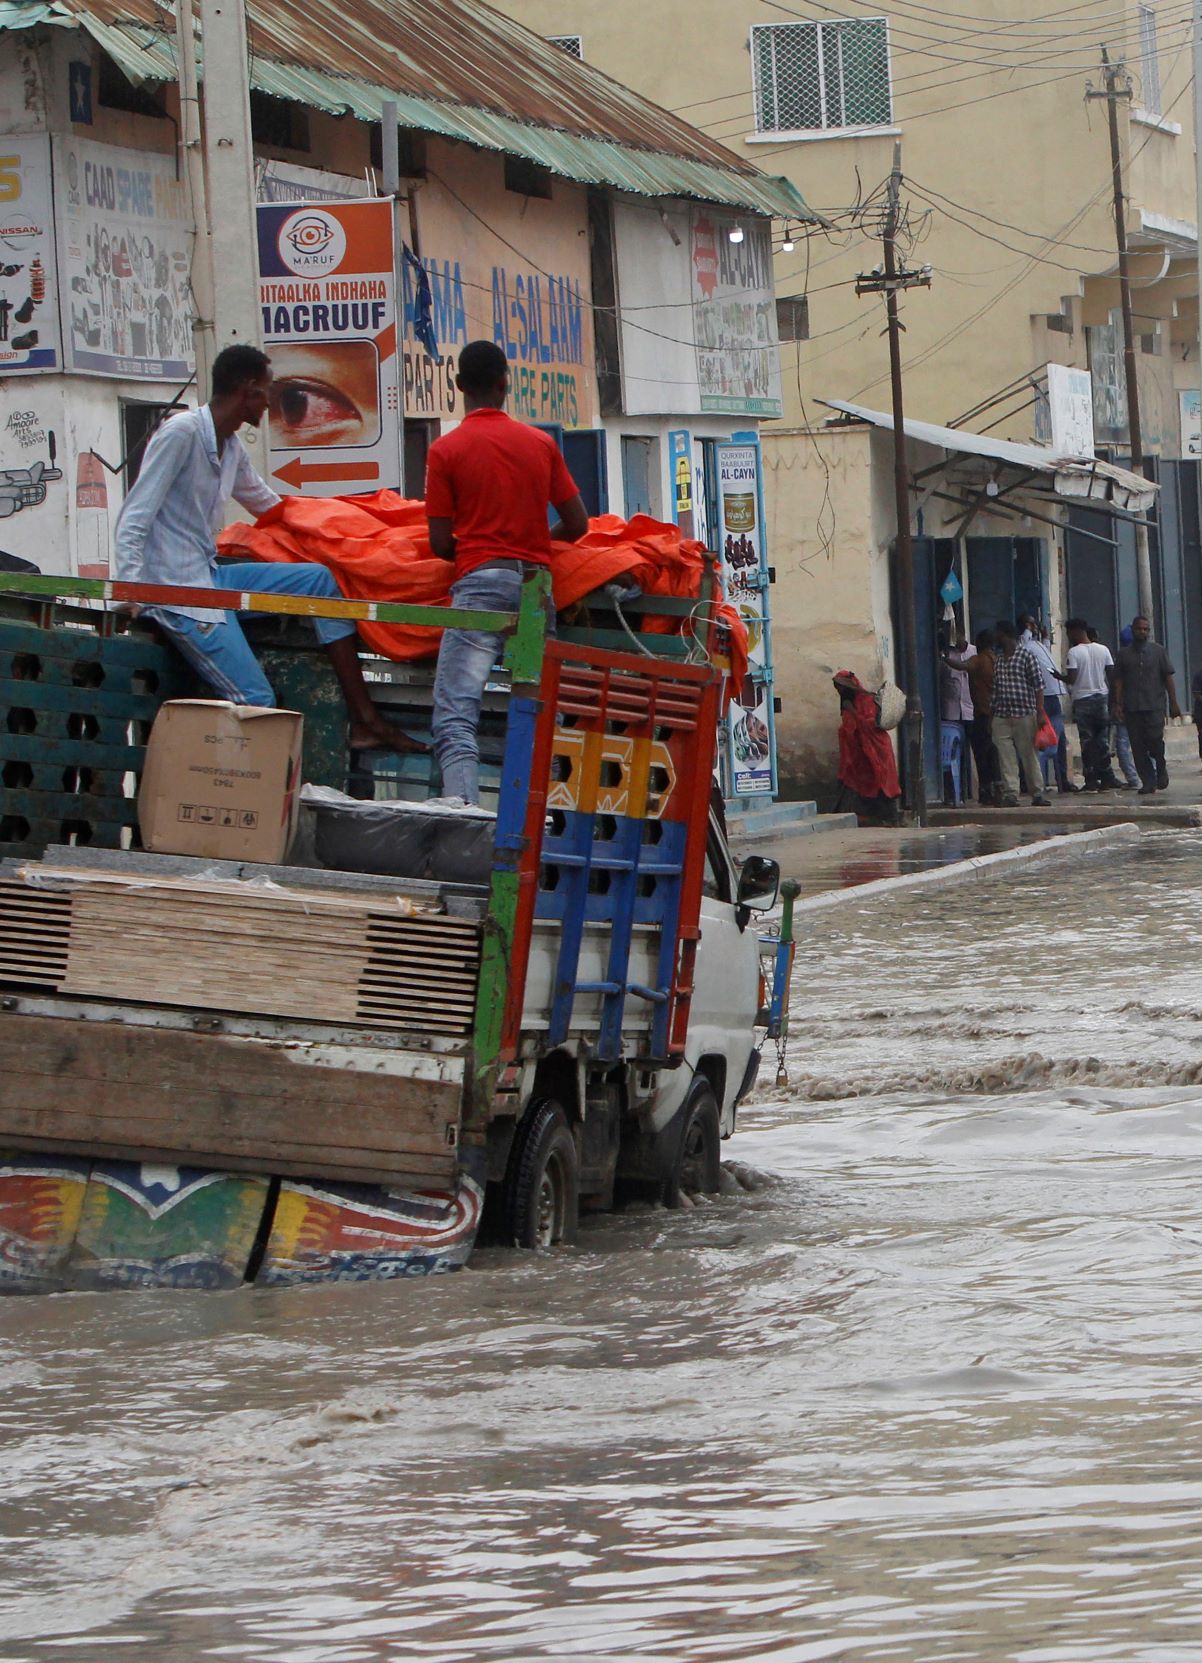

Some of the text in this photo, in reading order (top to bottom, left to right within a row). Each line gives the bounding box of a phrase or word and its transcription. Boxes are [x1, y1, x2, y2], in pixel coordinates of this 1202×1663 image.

[84, 160, 115, 211] CAAD
[0, 226, 39, 235] NISSAN
[326, 280, 387, 301] INDHAHA
[404, 353, 456, 413] PARTS
[506, 366, 578, 428] PARE PARTS
[721, 467, 755, 480] AL-CAYN
